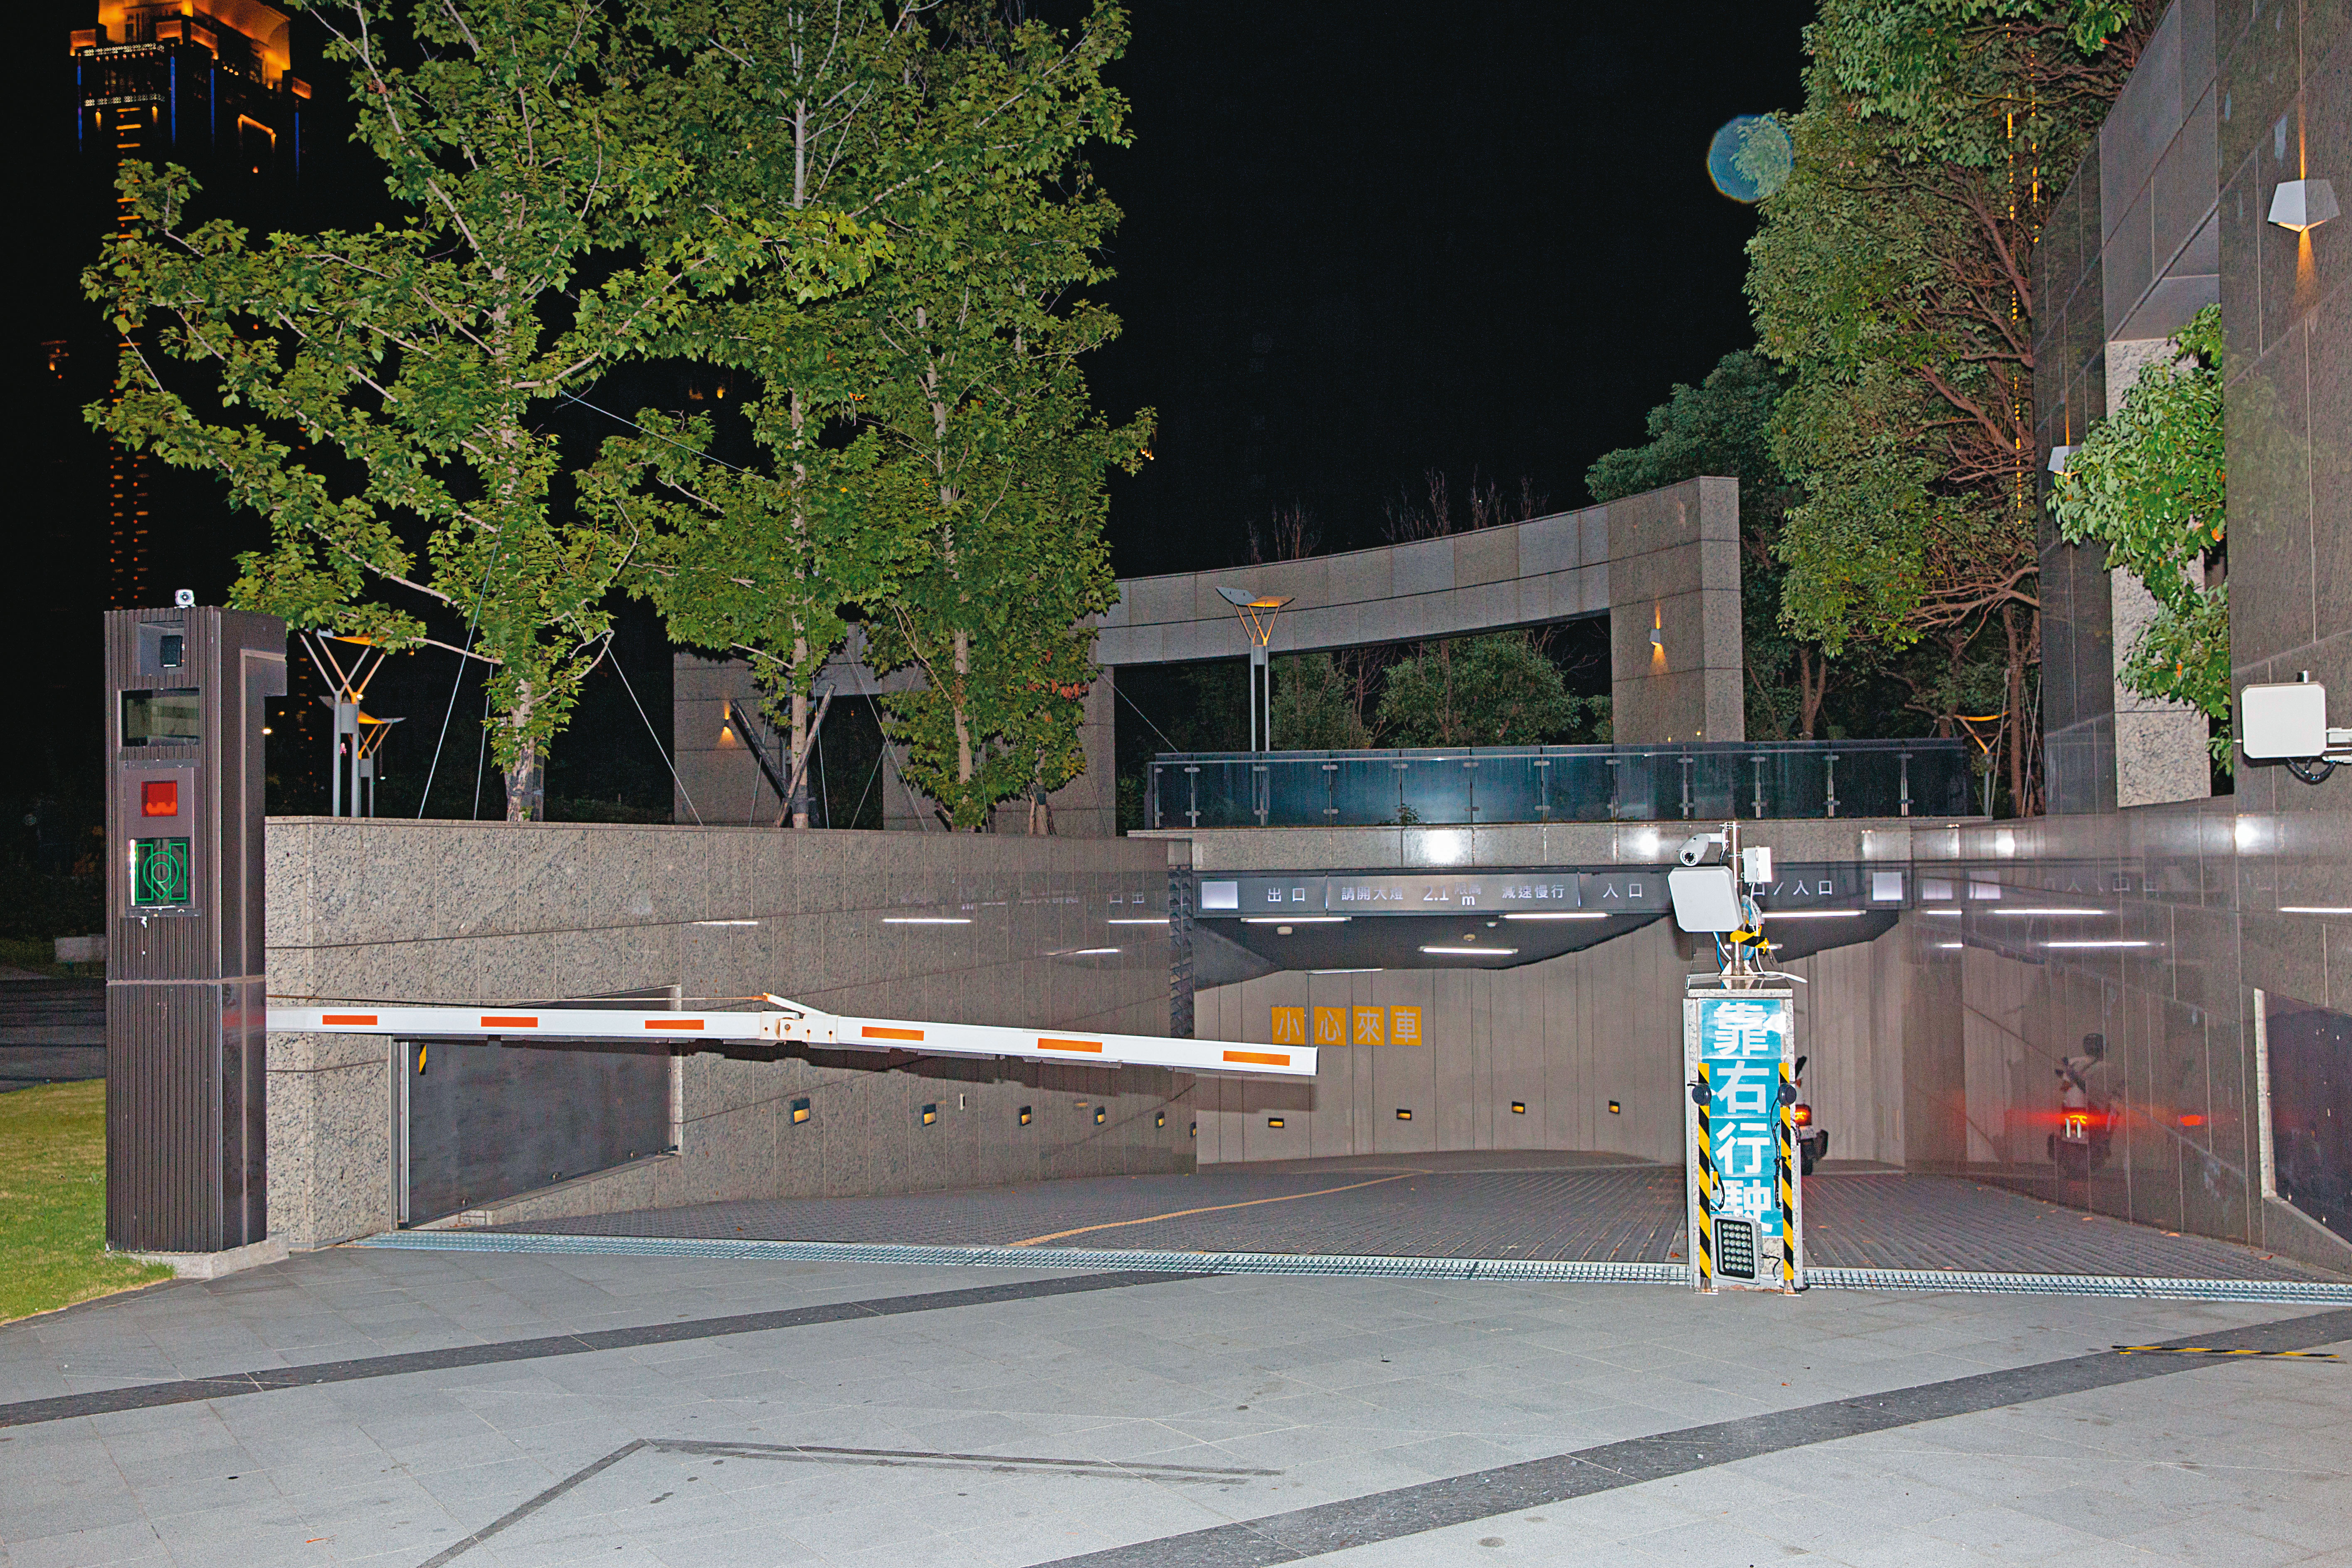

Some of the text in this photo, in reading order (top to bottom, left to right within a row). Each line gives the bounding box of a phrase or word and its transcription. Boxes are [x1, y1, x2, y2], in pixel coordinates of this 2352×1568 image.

[1268, 887, 1305, 902] 出口
[1341, 887, 1403, 900] 請開大燈
[1423, 885, 1449, 901] 2.1
[1455, 882, 1481, 894] 限高
[1502, 884, 1565, 899] 減速慢行
[1603, 883, 1642, 898] 入口
[1462, 895, 1475, 906] m
[1278, 1010, 1417, 1043] 小心來車
[1714, 1002, 1773, 1233] 靠右行駛
